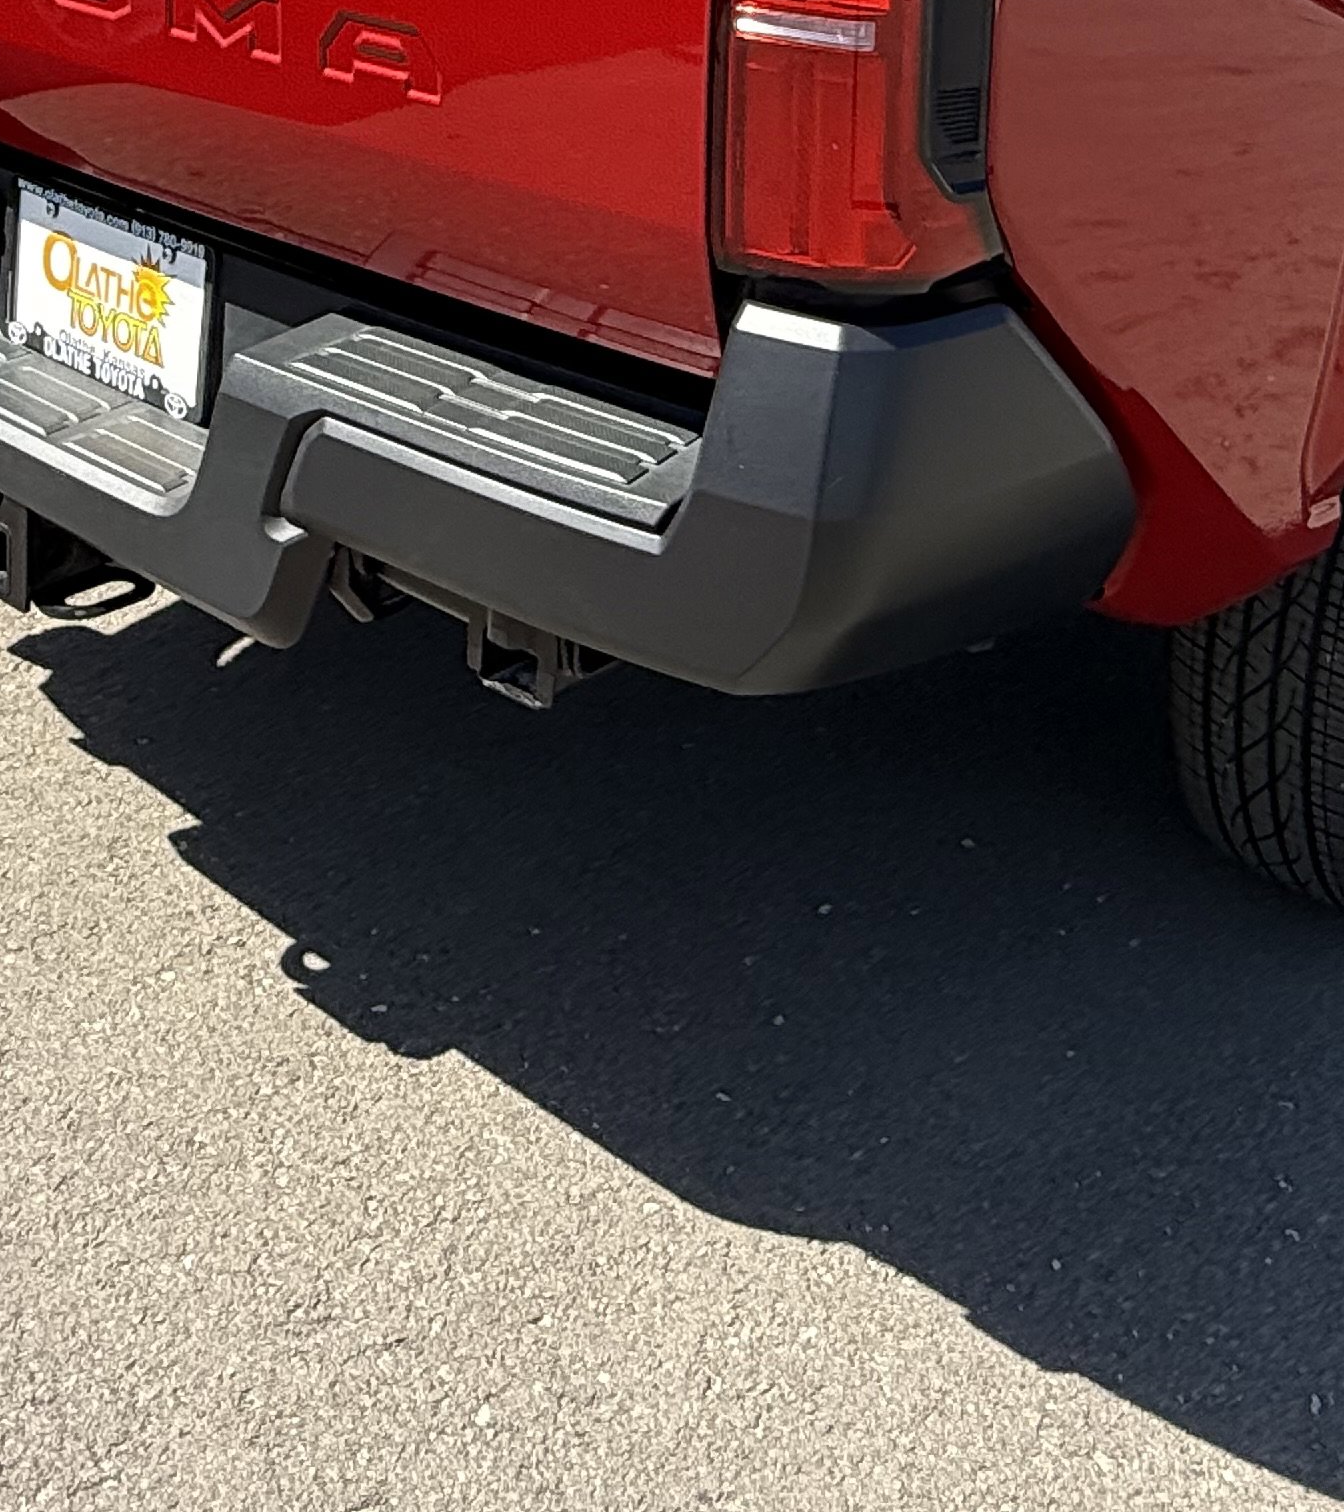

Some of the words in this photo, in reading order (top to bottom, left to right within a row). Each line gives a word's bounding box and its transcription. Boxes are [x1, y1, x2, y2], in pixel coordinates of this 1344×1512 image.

[67, 287, 165, 369] TOYOTA
[42, 336, 93, 374] OLATHE
[94, 357, 146, 401] TOYOTA
